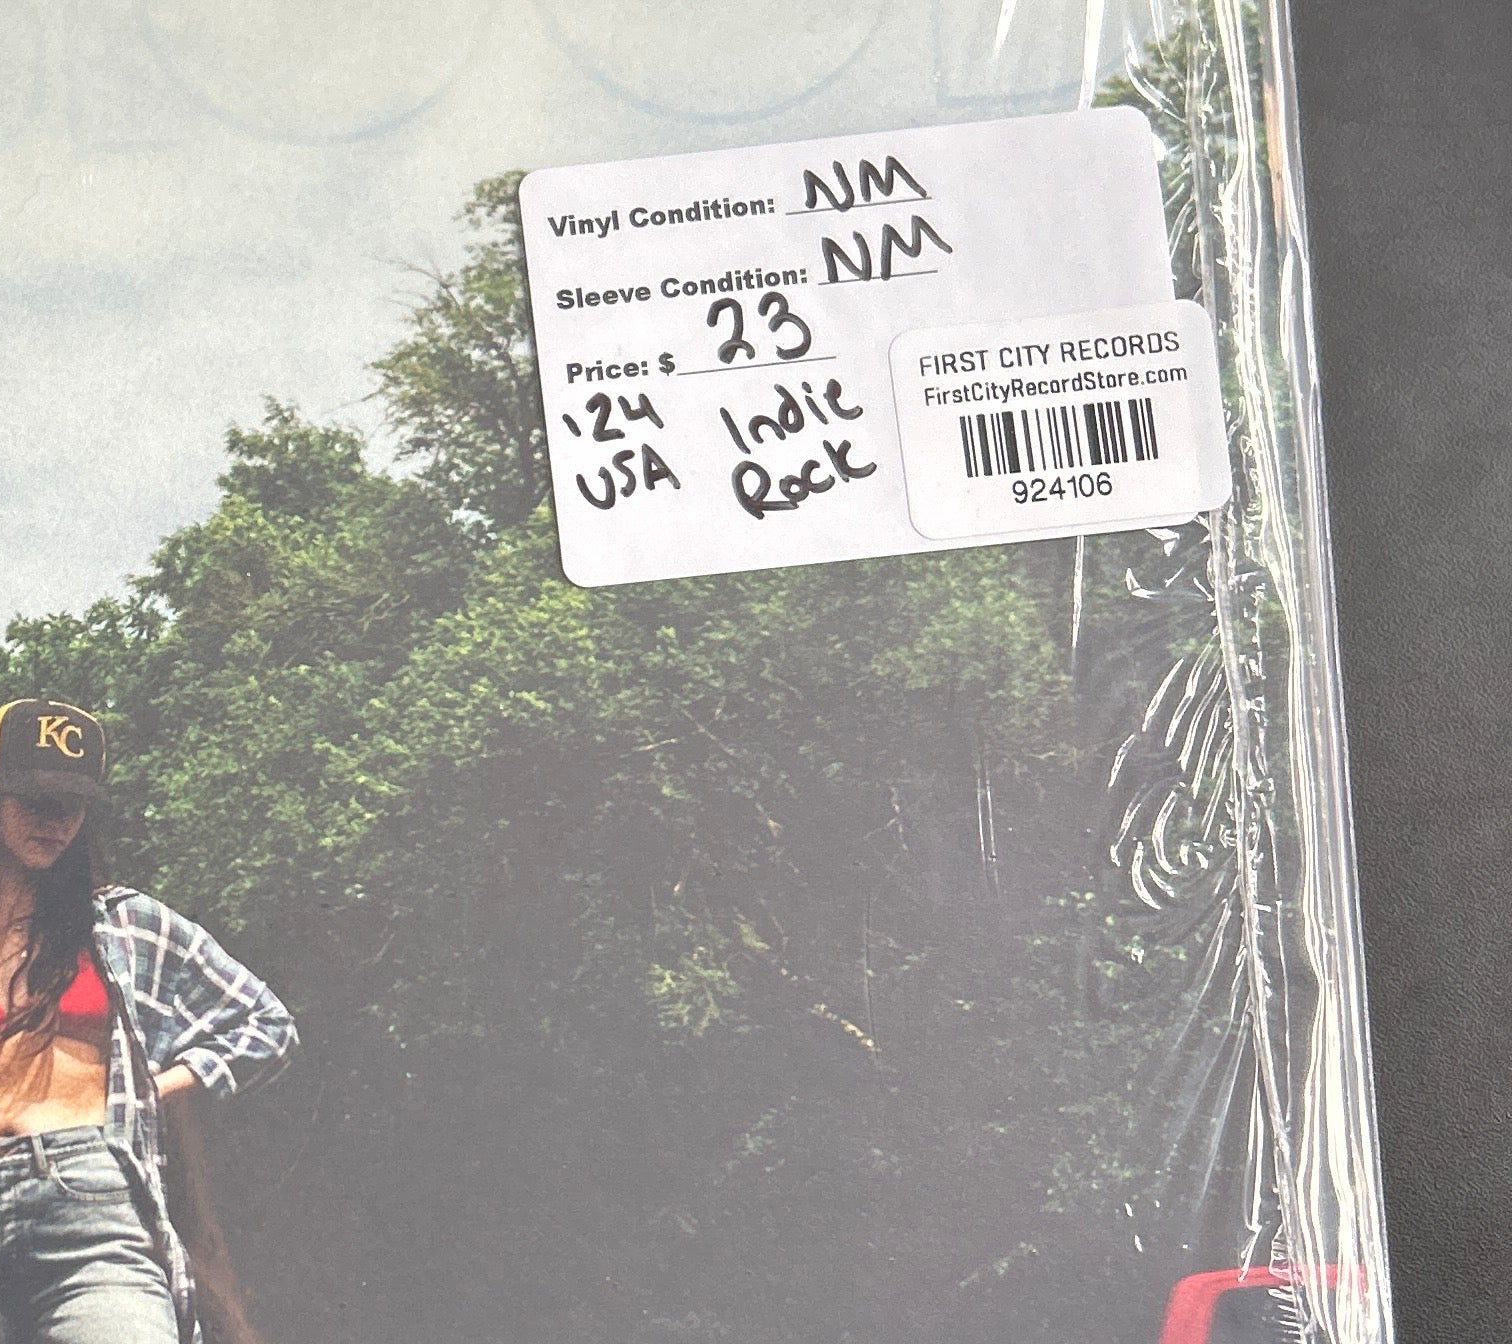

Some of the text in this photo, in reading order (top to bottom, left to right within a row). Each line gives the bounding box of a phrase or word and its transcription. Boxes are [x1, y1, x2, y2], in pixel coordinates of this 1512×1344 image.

[547, 155, 928, 239] Vinyl Condition: NM
[556, 214, 954, 311] Sleeve Condition: NM
[566, 360, 649, 385] Price:
[706, 291, 812, 364] 23
[919, 330, 1181, 377] FIRST CITY RECORDS
[719, 378, 864, 455] Indie
[924, 366, 1188, 407] FirstCityRecordStore.com
[576, 443, 681, 510] USA
[731, 439, 878, 520] Rock
[1011, 471, 1113, 504] 924106
[36, 715, 85, 759] KC
